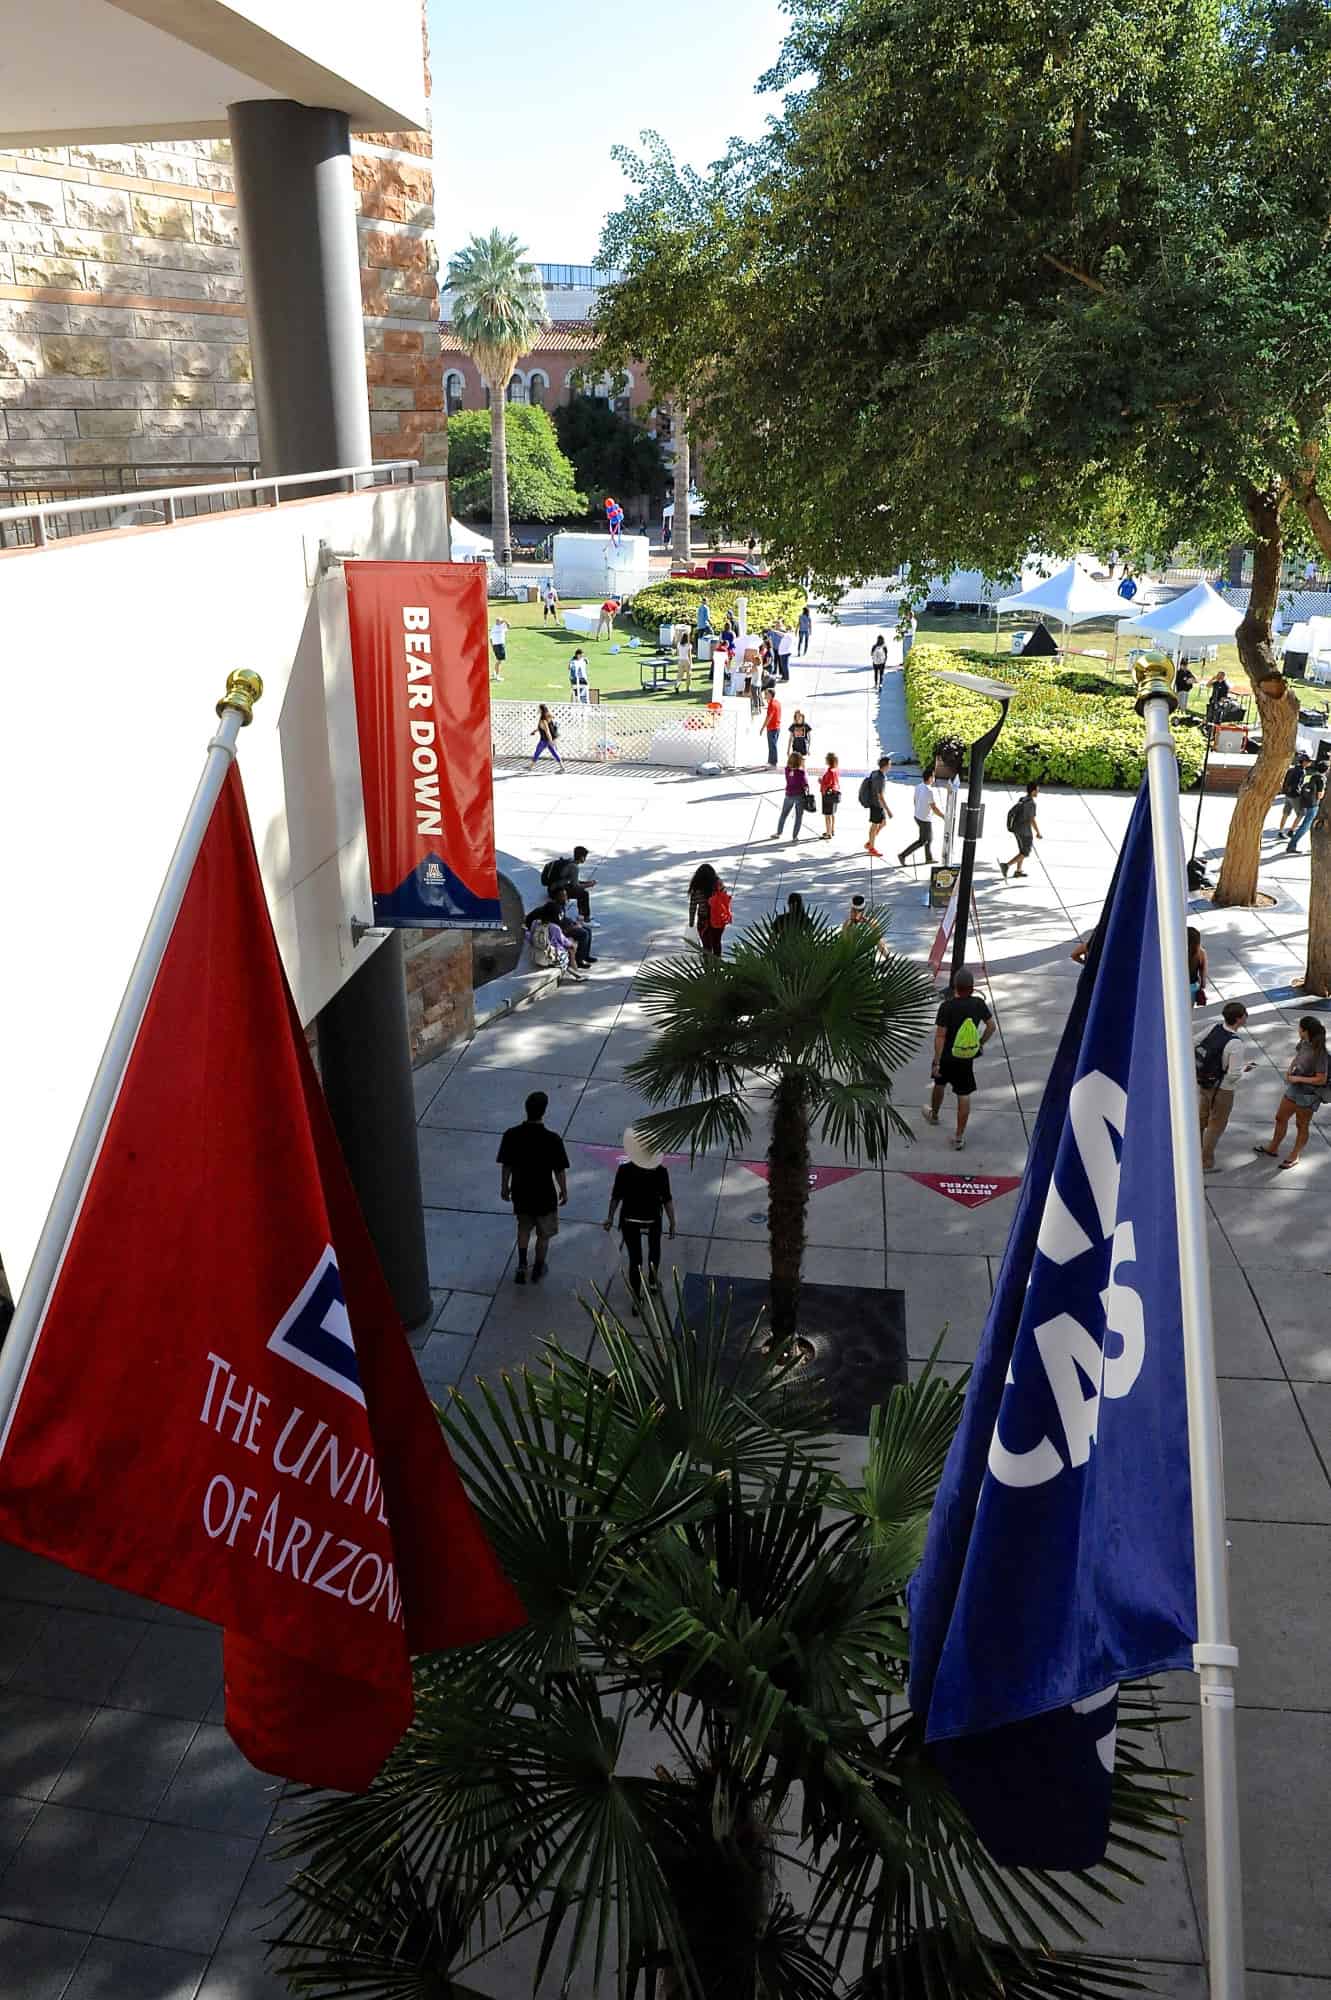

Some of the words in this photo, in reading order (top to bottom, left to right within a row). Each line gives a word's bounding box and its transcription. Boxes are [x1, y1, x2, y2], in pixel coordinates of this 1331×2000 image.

[401, 606, 434, 709] BEAR
[409, 719, 443, 836] DOWN
[200, 1351, 270, 1454] THE
[203, 1474, 258, 1547] OF
[254, 1490, 405, 1631] ARIZON
